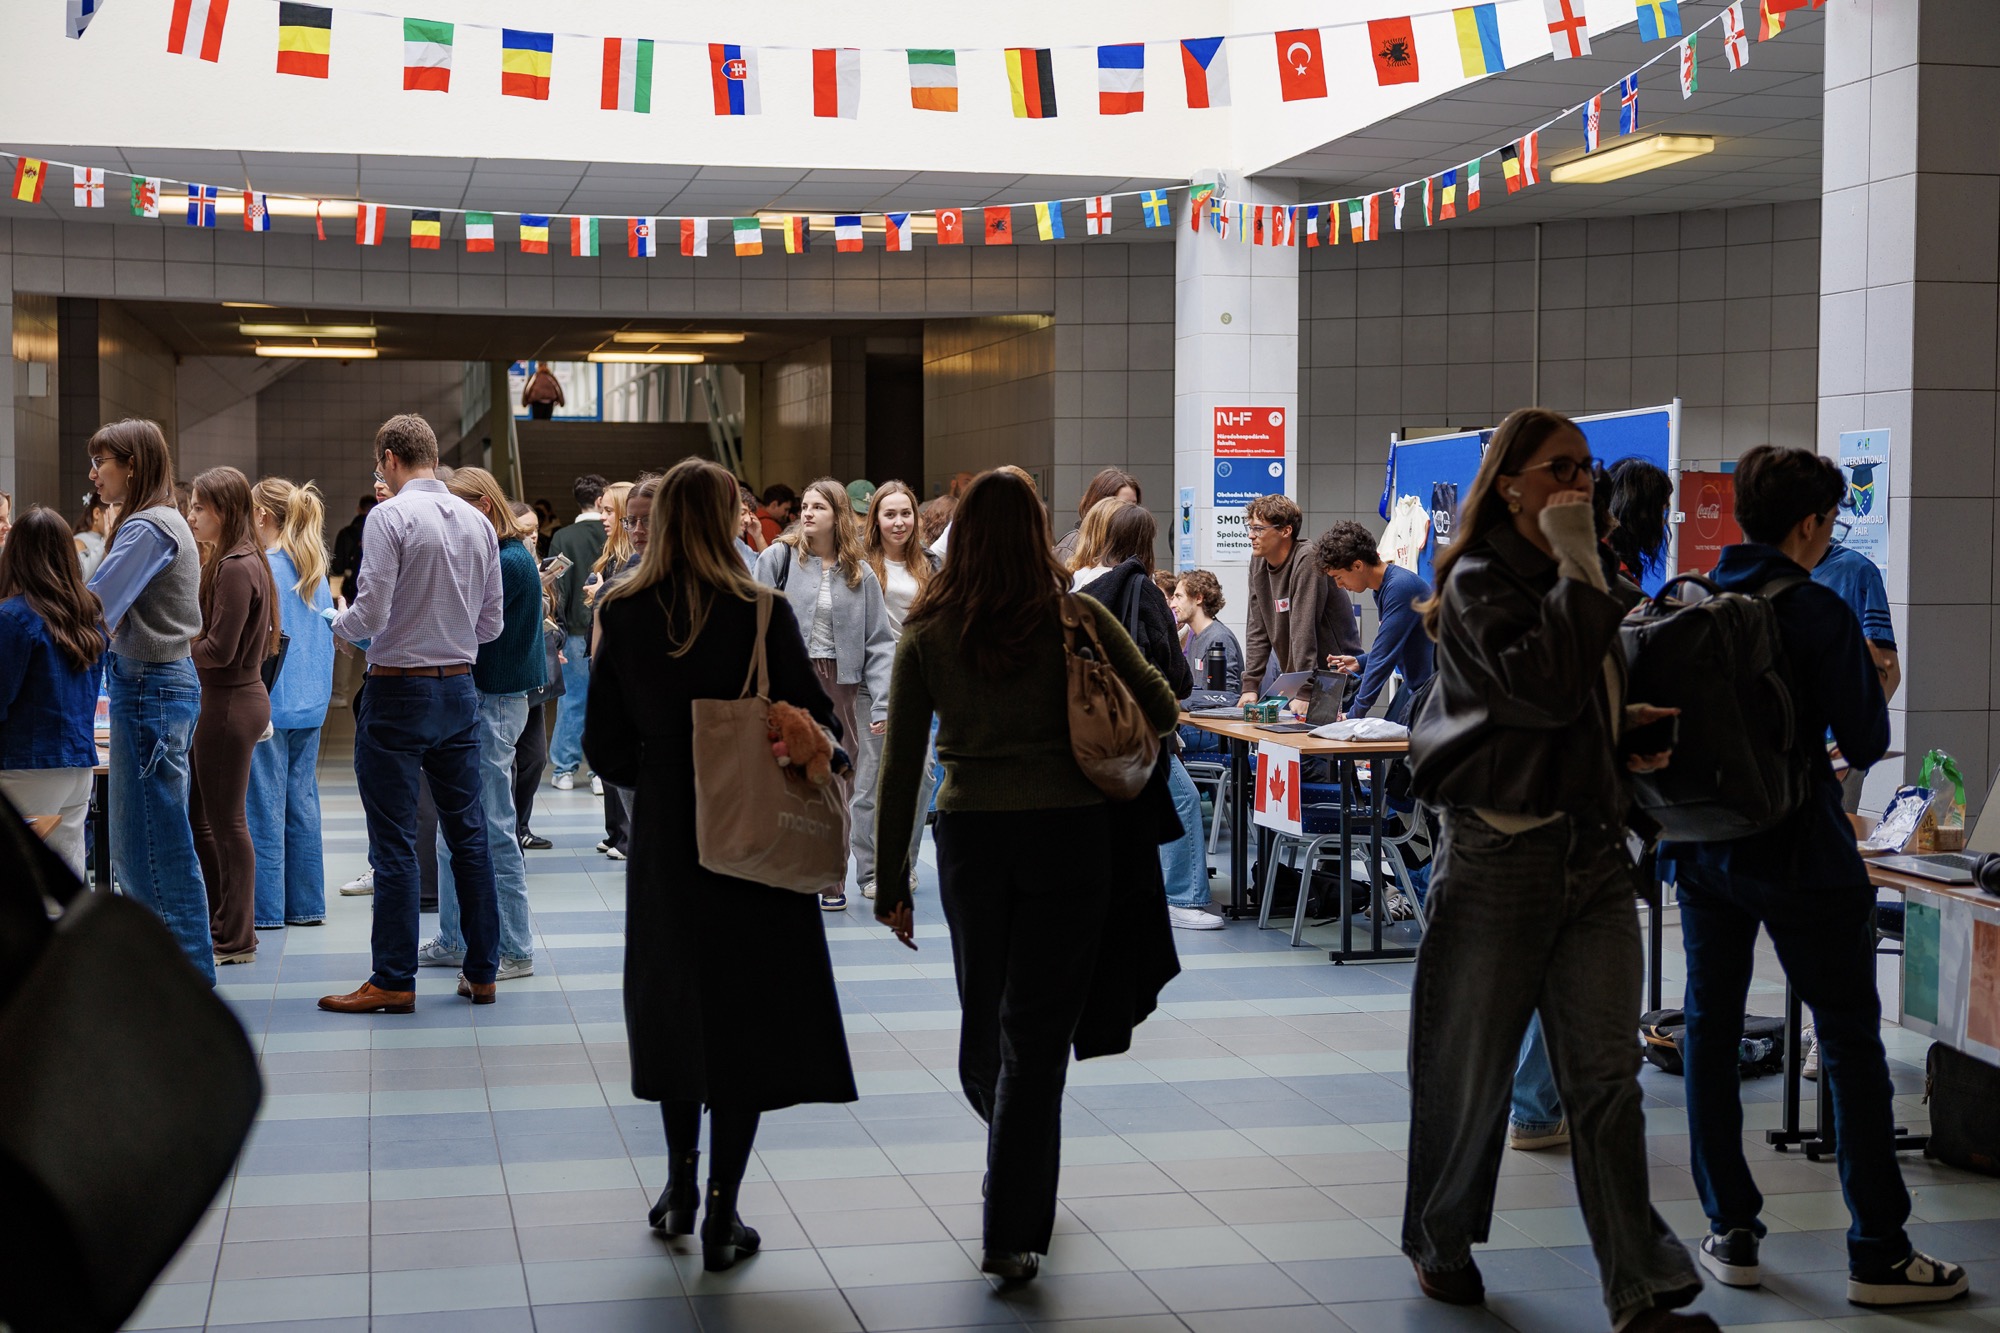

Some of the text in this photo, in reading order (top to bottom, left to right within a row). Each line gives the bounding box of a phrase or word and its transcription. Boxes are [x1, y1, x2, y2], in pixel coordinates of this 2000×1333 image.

[1840, 454, 1887, 465] INTERNATIONAL
[1859, 515, 1884, 525] ABROAD
[1854, 526, 1869, 536] FAIR
